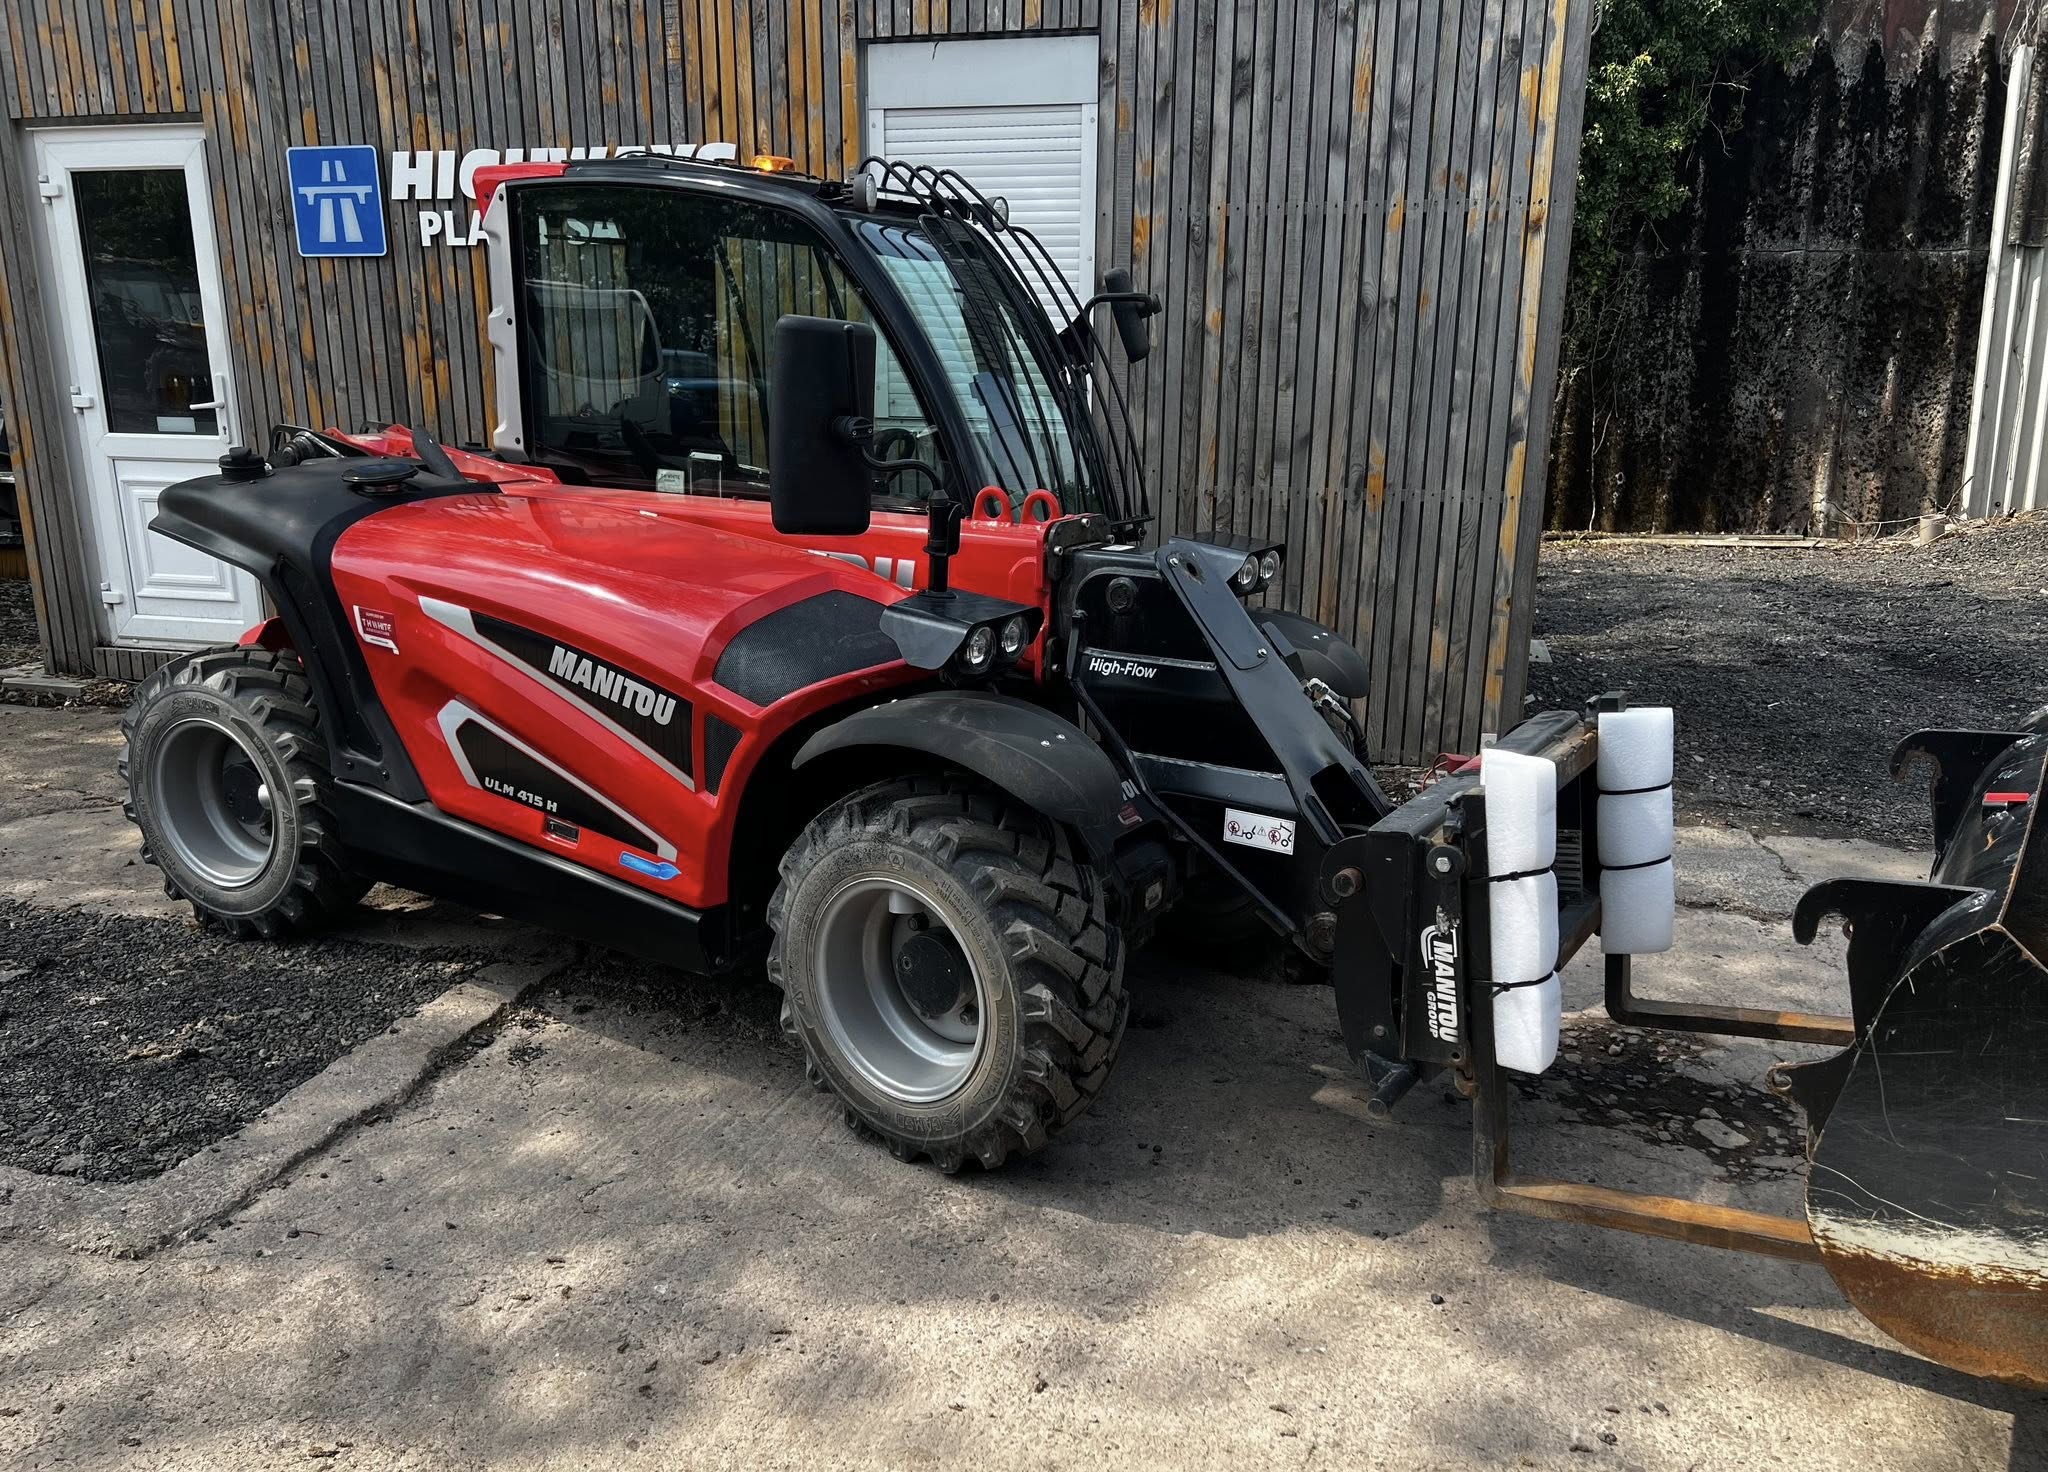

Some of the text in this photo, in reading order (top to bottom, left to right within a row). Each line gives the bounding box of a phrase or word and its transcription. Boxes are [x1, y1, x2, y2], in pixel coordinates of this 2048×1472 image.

[548, 645, 677, 726] MANITOU
[1089, 658, 1157, 678] High-Flow
[484, 776, 558, 813] ULM 415 H
[1426, 991, 1439, 1039] GROUP
[1433, 940, 1459, 1044] MANITOU
